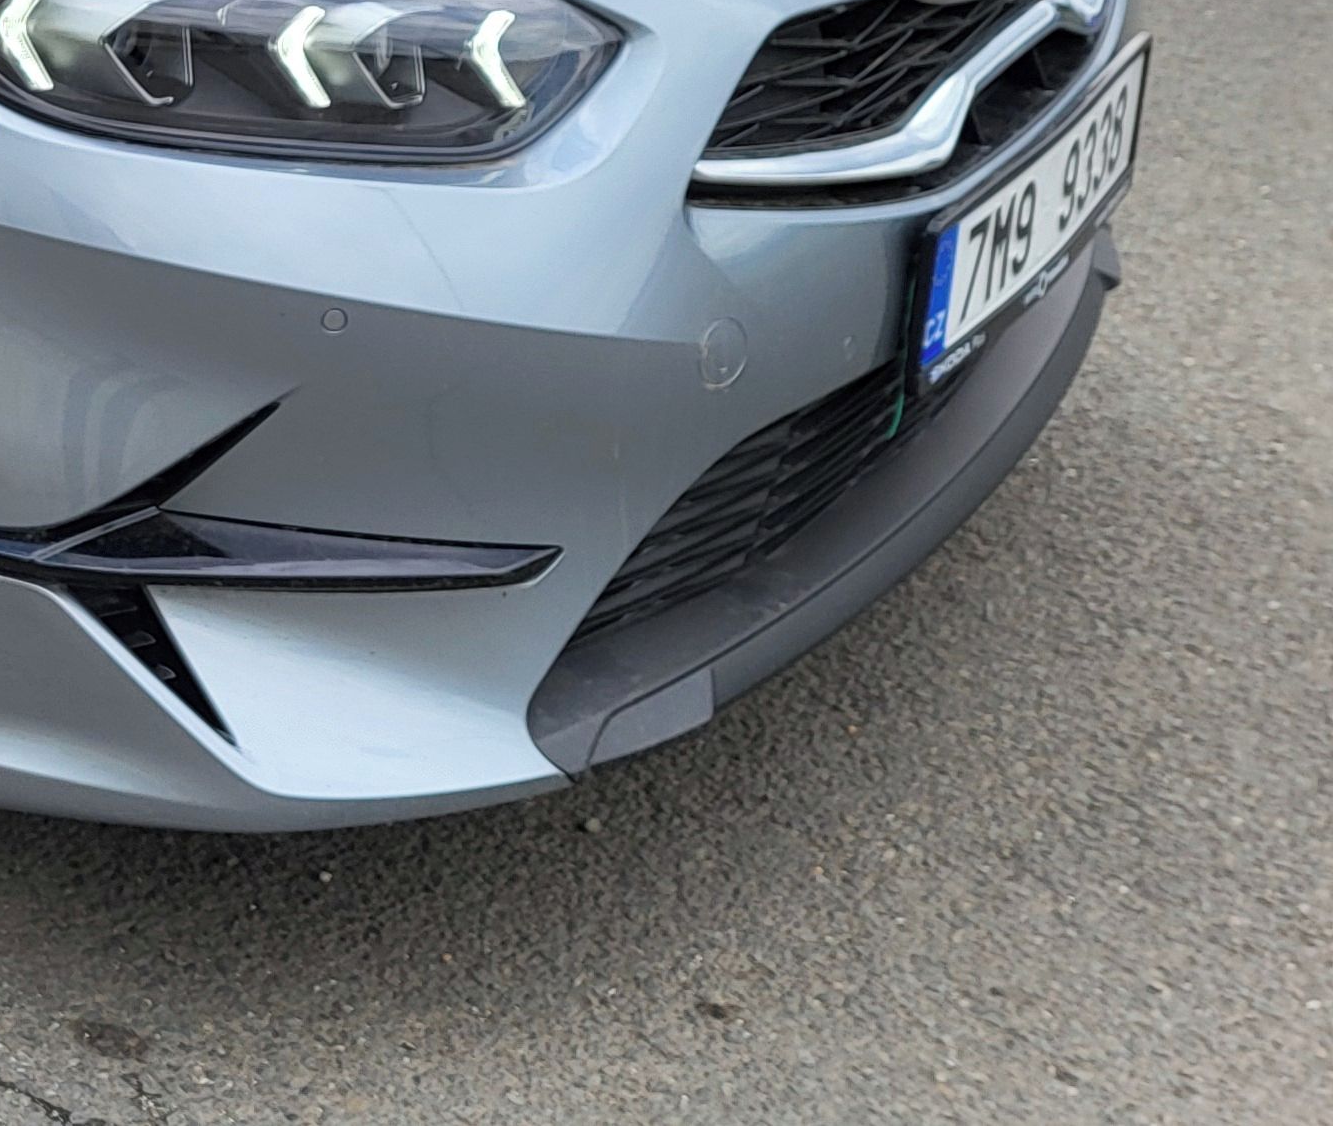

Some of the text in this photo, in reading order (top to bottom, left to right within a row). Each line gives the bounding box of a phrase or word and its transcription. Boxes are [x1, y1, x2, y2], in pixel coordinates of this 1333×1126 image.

[959, 83, 1128, 324] 7M9 9338
[922, 308, 946, 350] CZ
